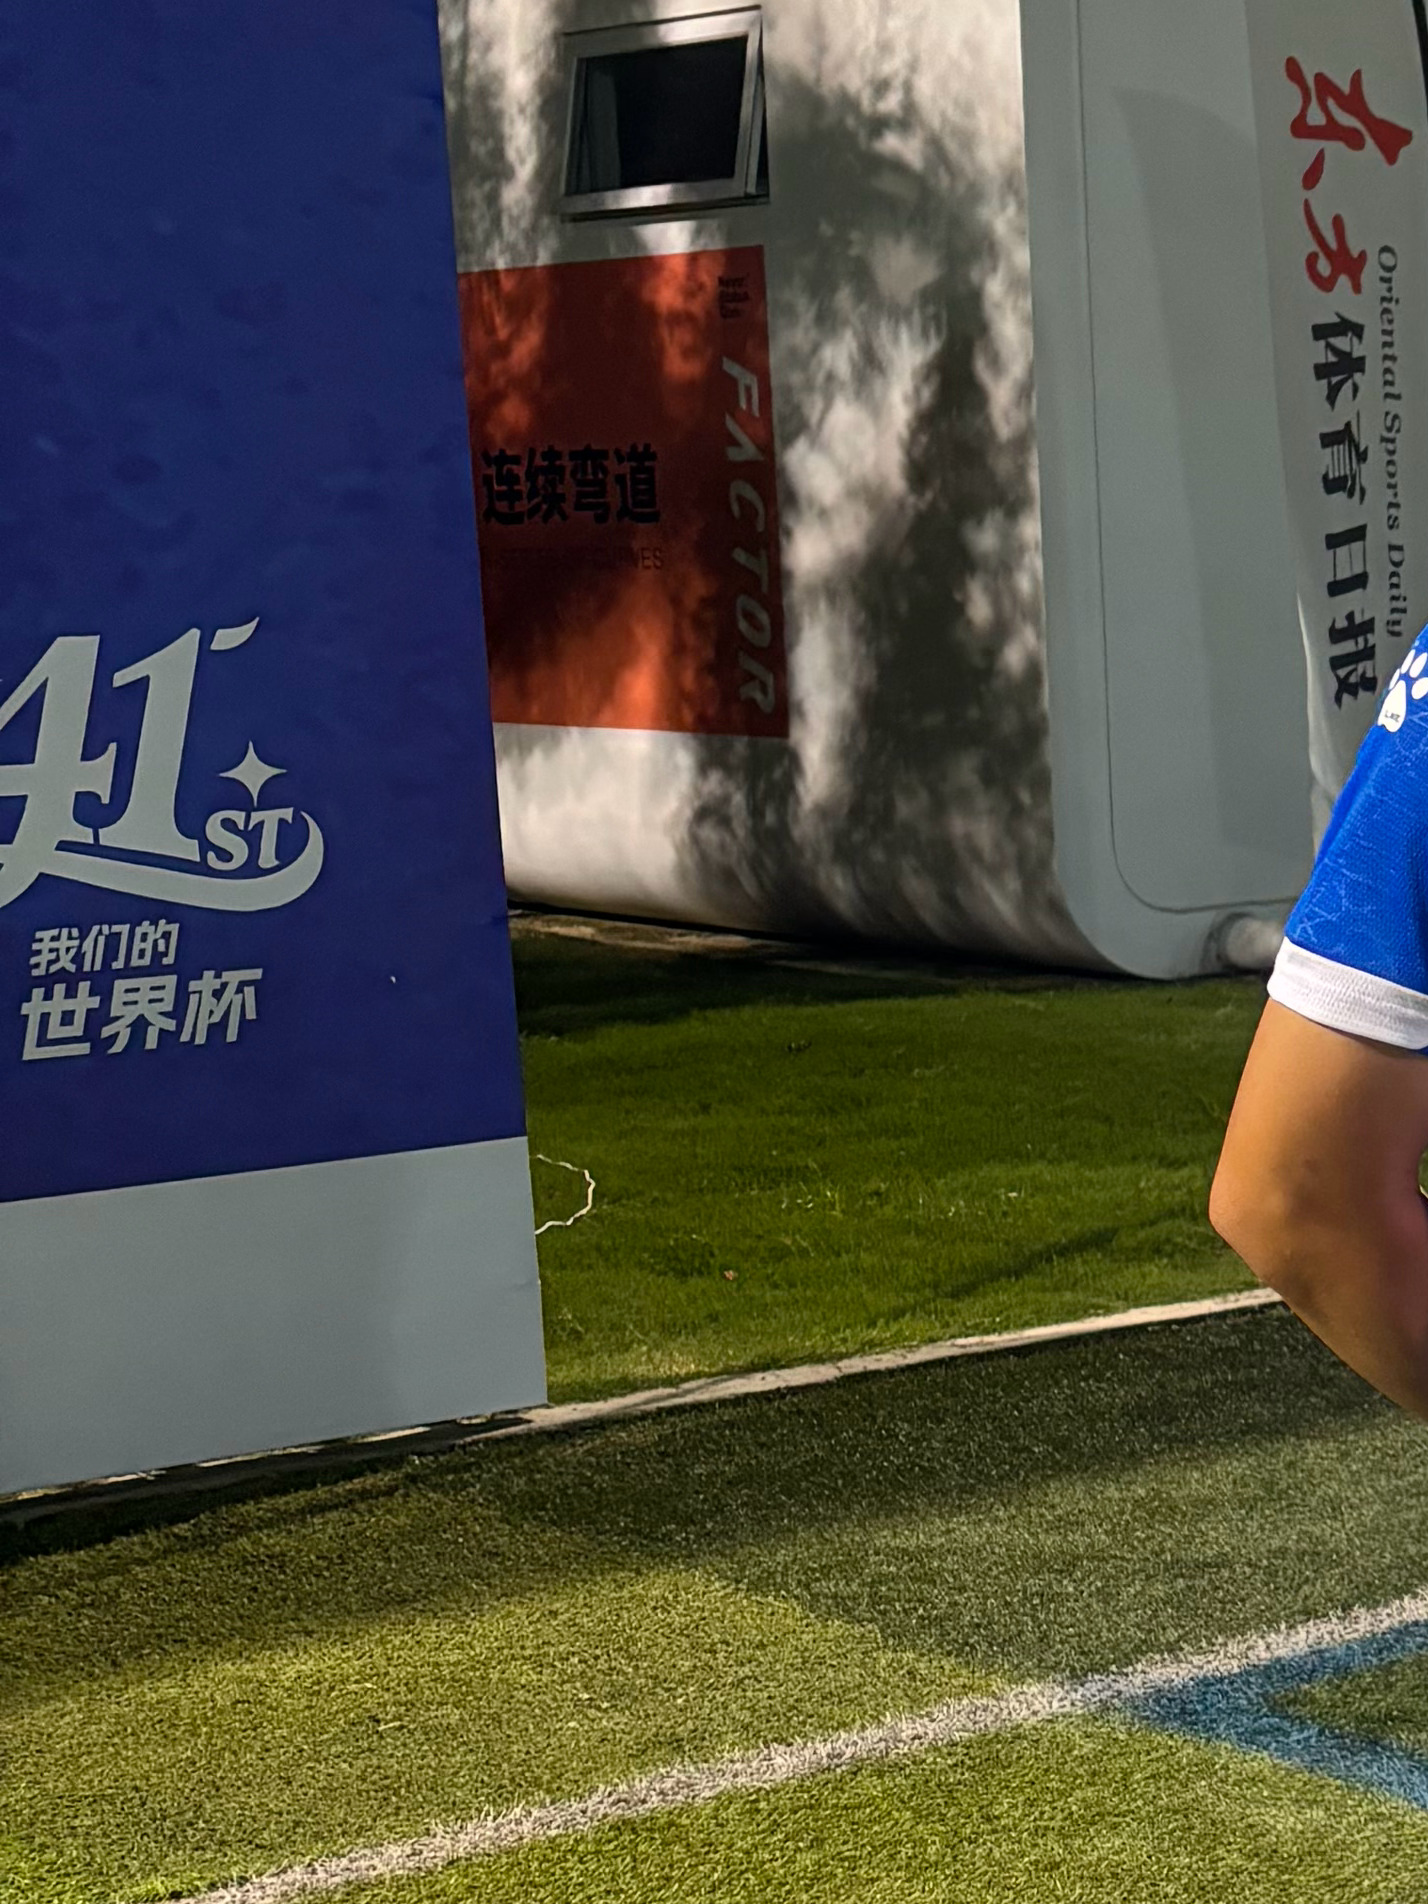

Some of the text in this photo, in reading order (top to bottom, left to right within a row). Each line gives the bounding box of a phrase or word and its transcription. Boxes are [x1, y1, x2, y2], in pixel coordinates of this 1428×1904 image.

[480, 443, 661, 526] 连续弯道
[1376, 244, 1408, 638] Oriental Sports Daily
[721, 355, 777, 715] FACTOR
[30, 919, 180, 977] 我们的
[20, 967, 264, 1062] 世界杯
